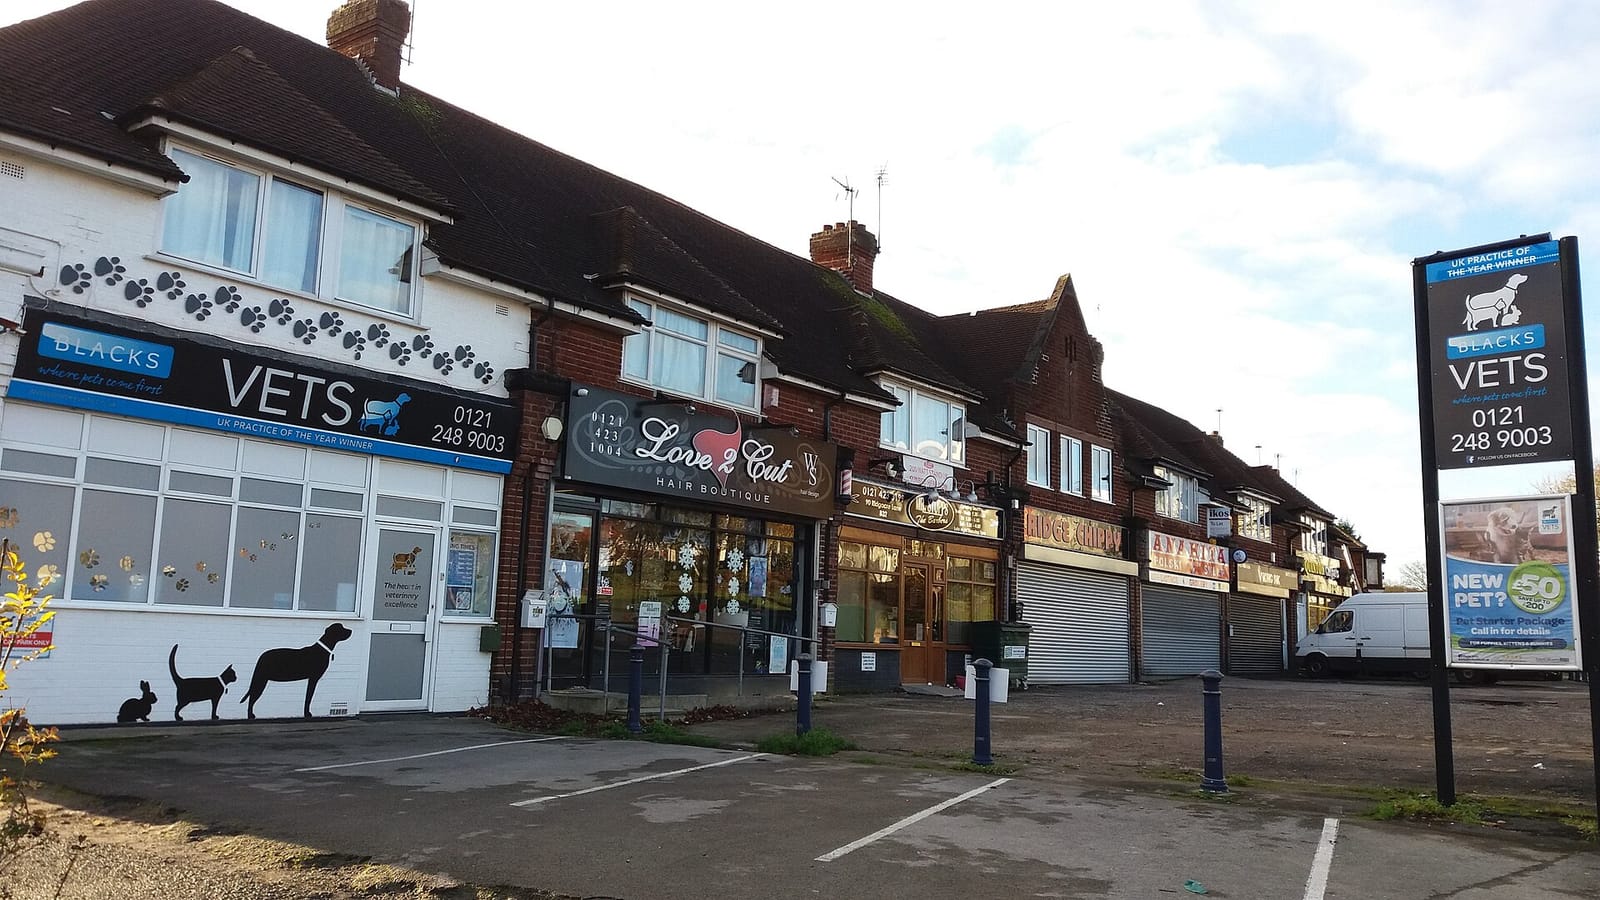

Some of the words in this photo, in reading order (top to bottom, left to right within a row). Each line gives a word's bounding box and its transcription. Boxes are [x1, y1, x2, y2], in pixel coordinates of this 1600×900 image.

[1447, 268, 1466, 278] THE
[1467, 264, 1493, 274] YEAR
[1495, 255, 1537, 269] WINNER
[1451, 258, 1465, 268] UK
[1467, 250, 1513, 265] PRACTICE
[1515, 246, 1530, 256] OF
[53, 335, 160, 369] BLACKS
[1457, 331, 1535, 353] BLACKS
[38, 364, 80, 380] where
[79, 372, 103, 386] pets
[105, 378, 135, 390] come
[135, 378, 164, 395] first
[1448, 352, 1548, 390] VETS
[222, 358, 355, 427] VETS
[454, 405, 492, 429] 0121
[592, 411, 623, 427] 0121
[1472, 405, 1523, 428] 0121
[216, 417, 230, 428] UK
[233, 420, 278, 436] PRACTICE
[279, 428, 294, 438] OF
[295, 430, 312, 441] THE
[314, 433, 337, 444] YEAR
[339, 438, 373, 450] WINNER
[431, 424, 463, 446] 248
[467, 430, 505, 453] 9003
[595, 428, 618, 442] 423
[1451, 432, 1490, 452] 248
[1497, 426, 1553, 449] 9003
[590, 442, 621, 457] 1004
[635, 417, 713, 471] Love
[717, 447, 738, 474] 2
[742, 439, 793, 483] Cut
[656, 477, 693, 491] HAIR
[701, 484, 770, 504] BOUTIQUE
[862, 486, 877, 497] 0121
[1209, 509, 1230, 518] ikos
[1076, 520, 1122, 552] CHIPPY
[1153, 534, 1226, 564] ANAHITA
[1453, 573, 1503, 590] NEW
[1455, 591, 1507, 608] PET?
[1471, 626, 1489, 635] Call
[1490, 626, 1499, 635] in
[1500, 627, 1515, 635] for
[1516, 626, 1551, 635] details
[1476, 616, 1516, 626] Starter
[1517, 616, 1565, 627] Package
